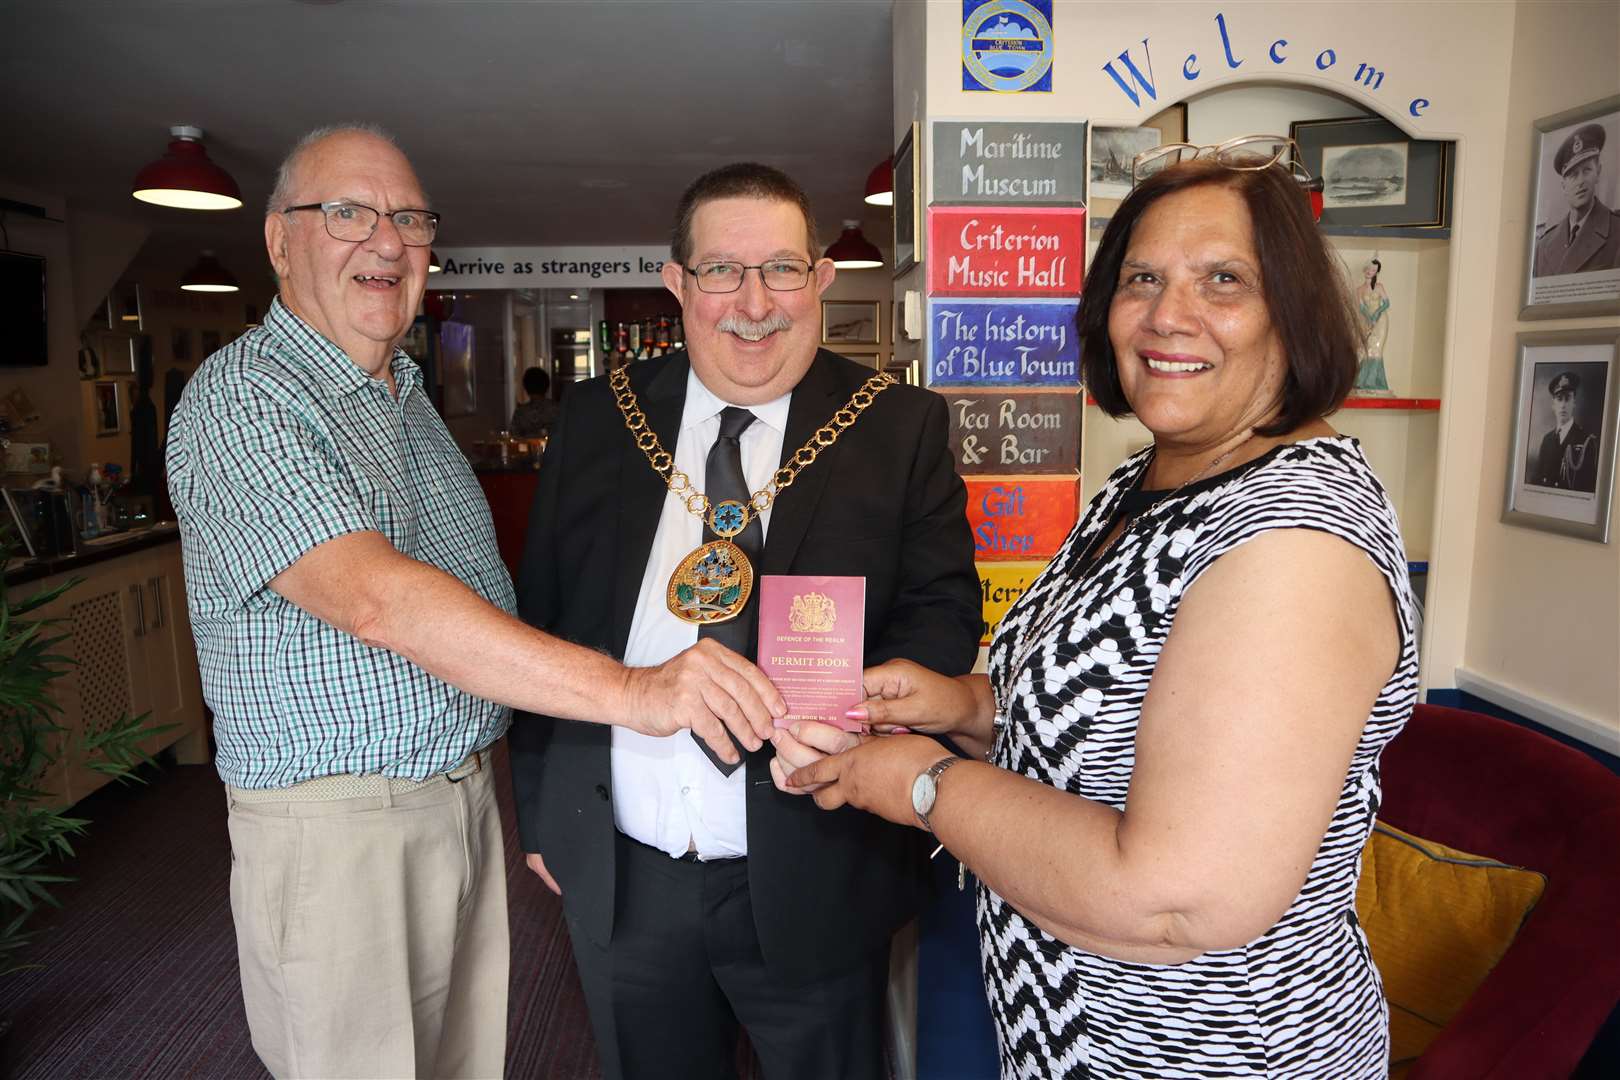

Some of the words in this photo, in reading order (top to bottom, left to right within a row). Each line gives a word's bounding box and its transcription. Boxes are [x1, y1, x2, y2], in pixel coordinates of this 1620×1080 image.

[1101, 13, 1430, 118] Welcome
[960, 127, 1063, 160] Maritime
[961, 164, 1057, 197] Museum
[960, 219, 1061, 252] Criterion
[442, 257, 505, 275] Arrive
[513, 260, 533, 274] as
[541, 257, 631, 278] strangers
[948, 255, 1010, 288] Music
[1017, 255, 1068, 288] Hall
[935, 309, 978, 342] The
[984, 311, 1066, 352] history
[935, 346, 962, 377] of
[962, 346, 1015, 378] Blue
[1015, 345, 1075, 377] Town
[954, 398, 990, 430] Tea
[998, 398, 1062, 430] Room
[962, 434, 988, 465] &
[1000, 434, 1051, 465] Bar
[982, 485, 1025, 517] Gift
[975, 521, 1035, 553] Shop
[771, 656, 815, 667] PERMIT
[816, 657, 849, 668] BOOK
